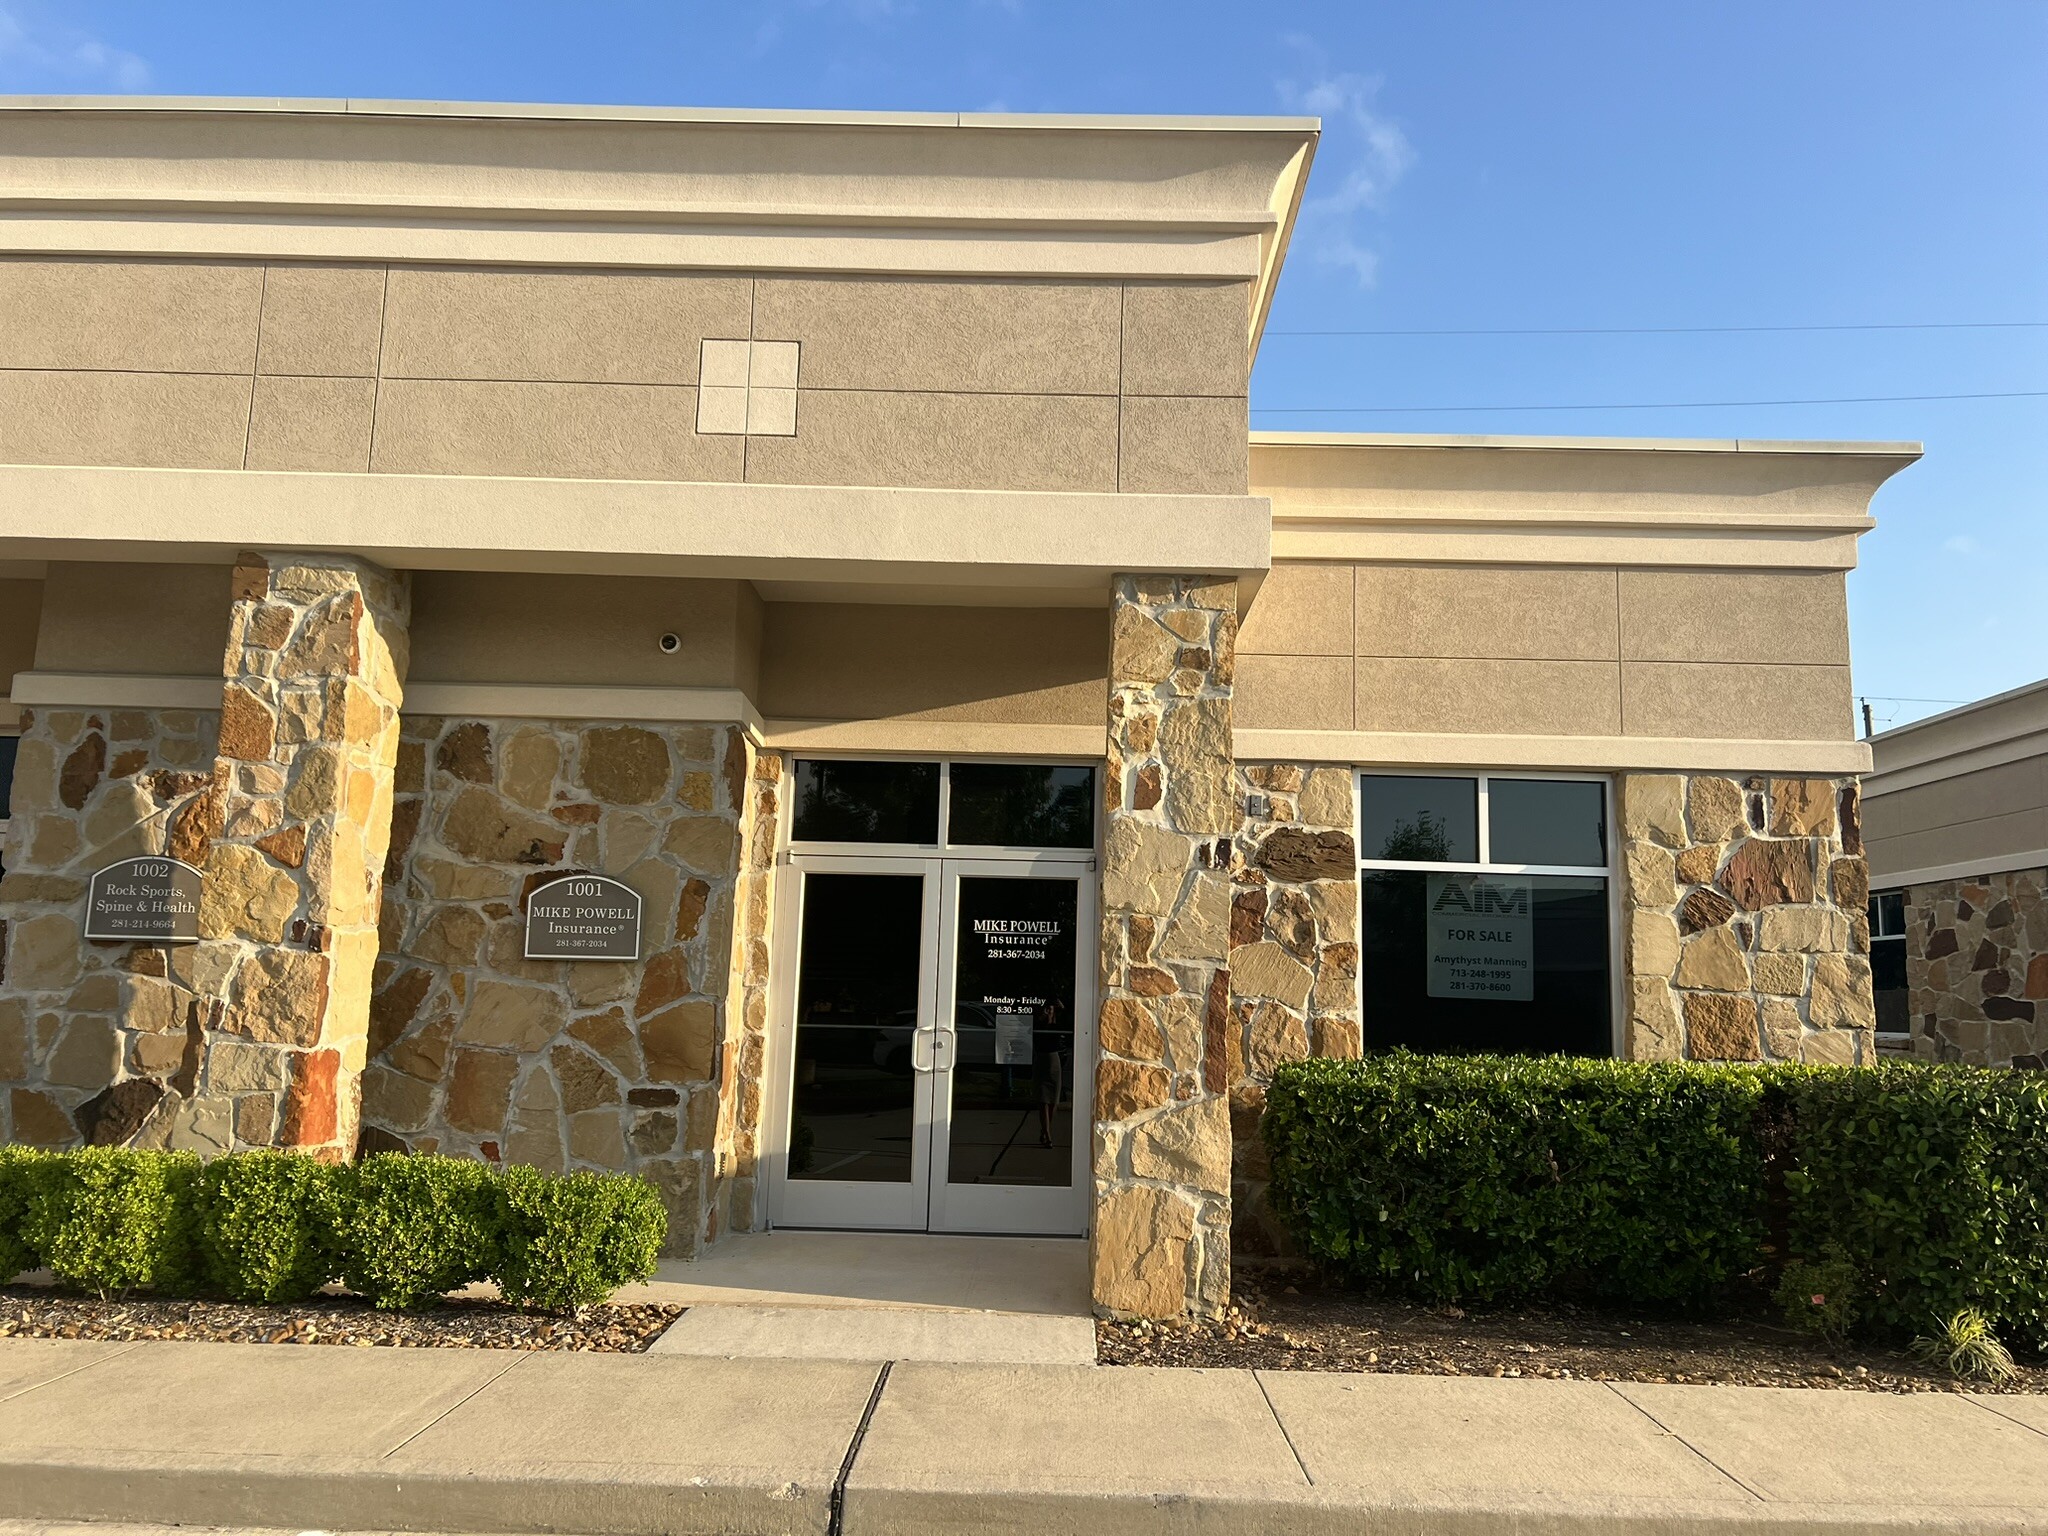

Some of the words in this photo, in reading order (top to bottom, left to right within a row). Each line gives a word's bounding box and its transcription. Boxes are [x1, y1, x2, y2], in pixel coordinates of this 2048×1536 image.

[132, 864, 169, 877] 1002
[106, 884, 137, 896] Rock
[140, 885, 186, 898] Sports,
[566, 882, 603, 897] 1001
[1432, 883, 1528, 914] AIM
[96, 900, 133, 913] Spine
[136, 901, 148, 912] &
[151, 901, 196, 913] Health
[533, 906, 571, 918] MIKE
[575, 907, 635, 919] POWELL
[111, 919, 176, 929] 281-214-9664
[973, 919, 1008, 931] MIKE
[1010, 920, 1061, 933] POWELL
[1448, 929, 1476, 941] FOR
[1479, 930, 1513, 943] SALE
[556, 940, 607, 948] 281-367-2034
[987, 949, 1046, 960] 281-367-2034
[1433, 955, 1482, 966] Amythyst
[1484, 957, 1528, 969] Manning
[1450, 969, 1511, 979] 713-248-1995
[1449, 981, 1511, 992] 281-370-8600
[983, 995, 1016, 1006] Monday
[1021, 996, 1047, 1007] Friday
[996, 1006, 1012, 1014] 8:30
[1017, 1006, 1033, 1014] 5:00
